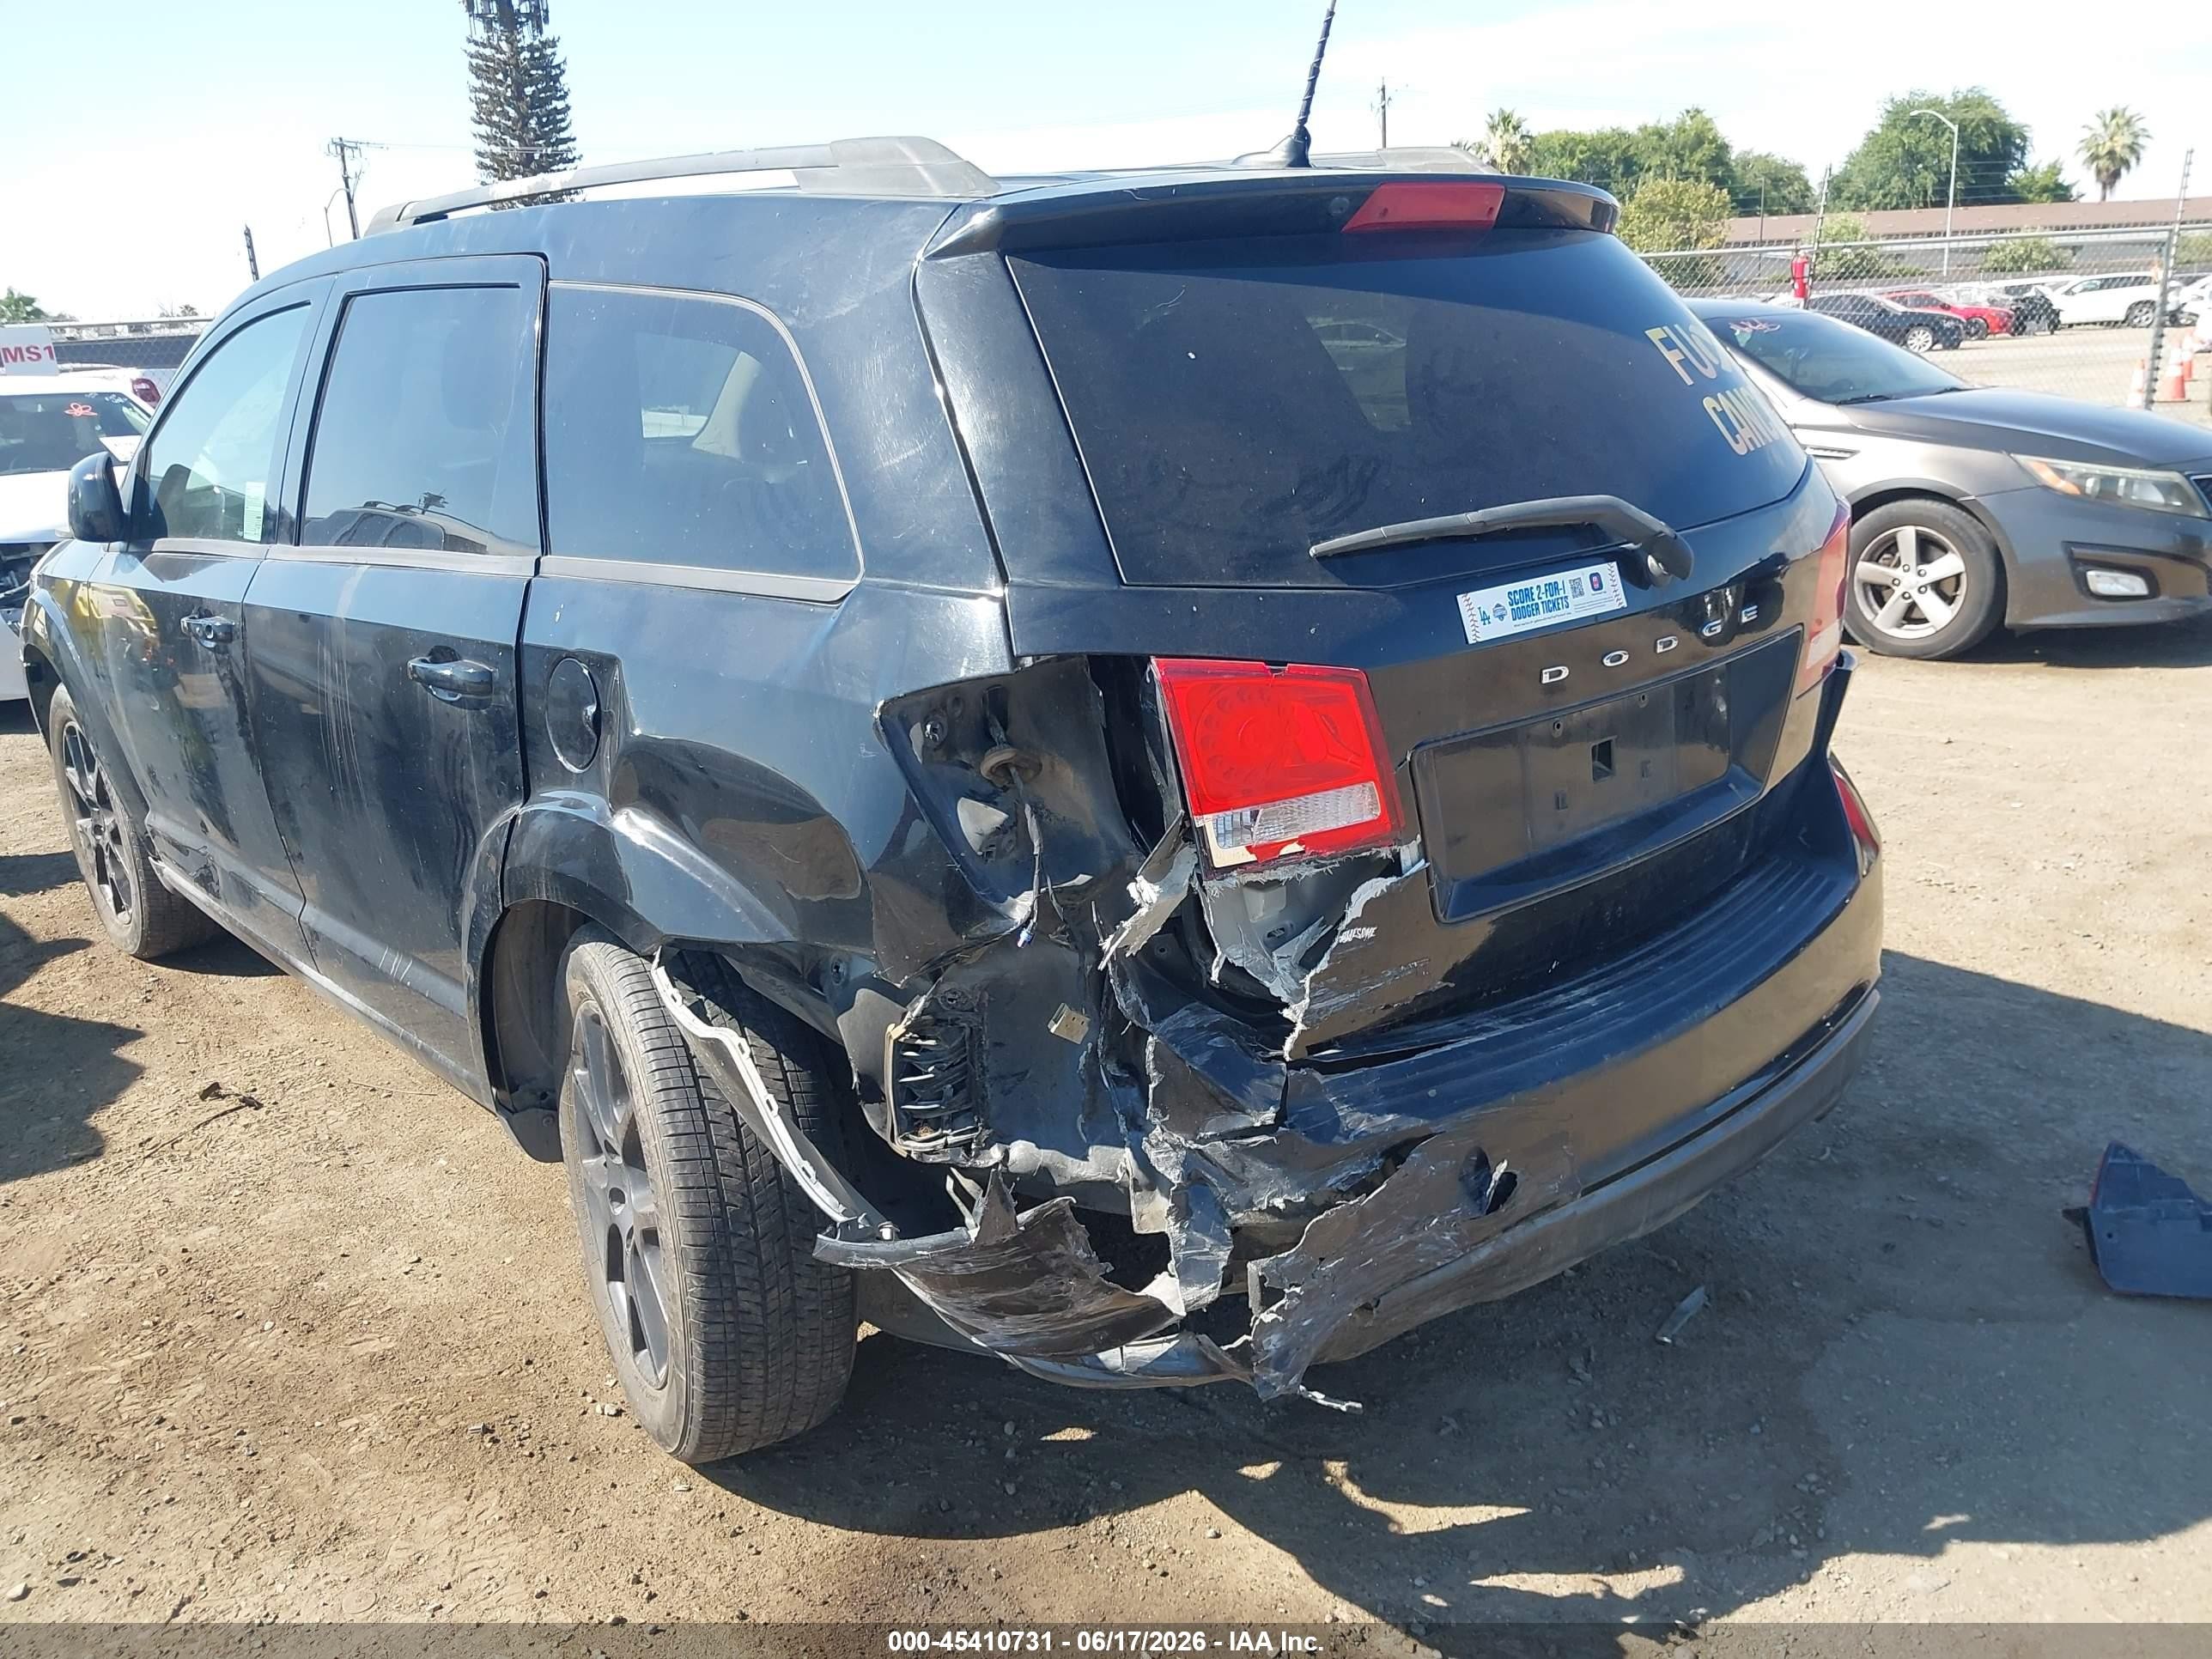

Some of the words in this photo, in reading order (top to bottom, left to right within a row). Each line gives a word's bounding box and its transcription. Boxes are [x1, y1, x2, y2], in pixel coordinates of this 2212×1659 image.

[2, 345, 54, 363] MS1
[1507, 586, 1535, 606] SCORE
[1536, 580, 1566, 600] 2-FOR-1
[1511, 602, 1540, 621] DODGER
[1541, 595, 1570, 614] TICKETS
[1541, 605, 1758, 684] DODGE
